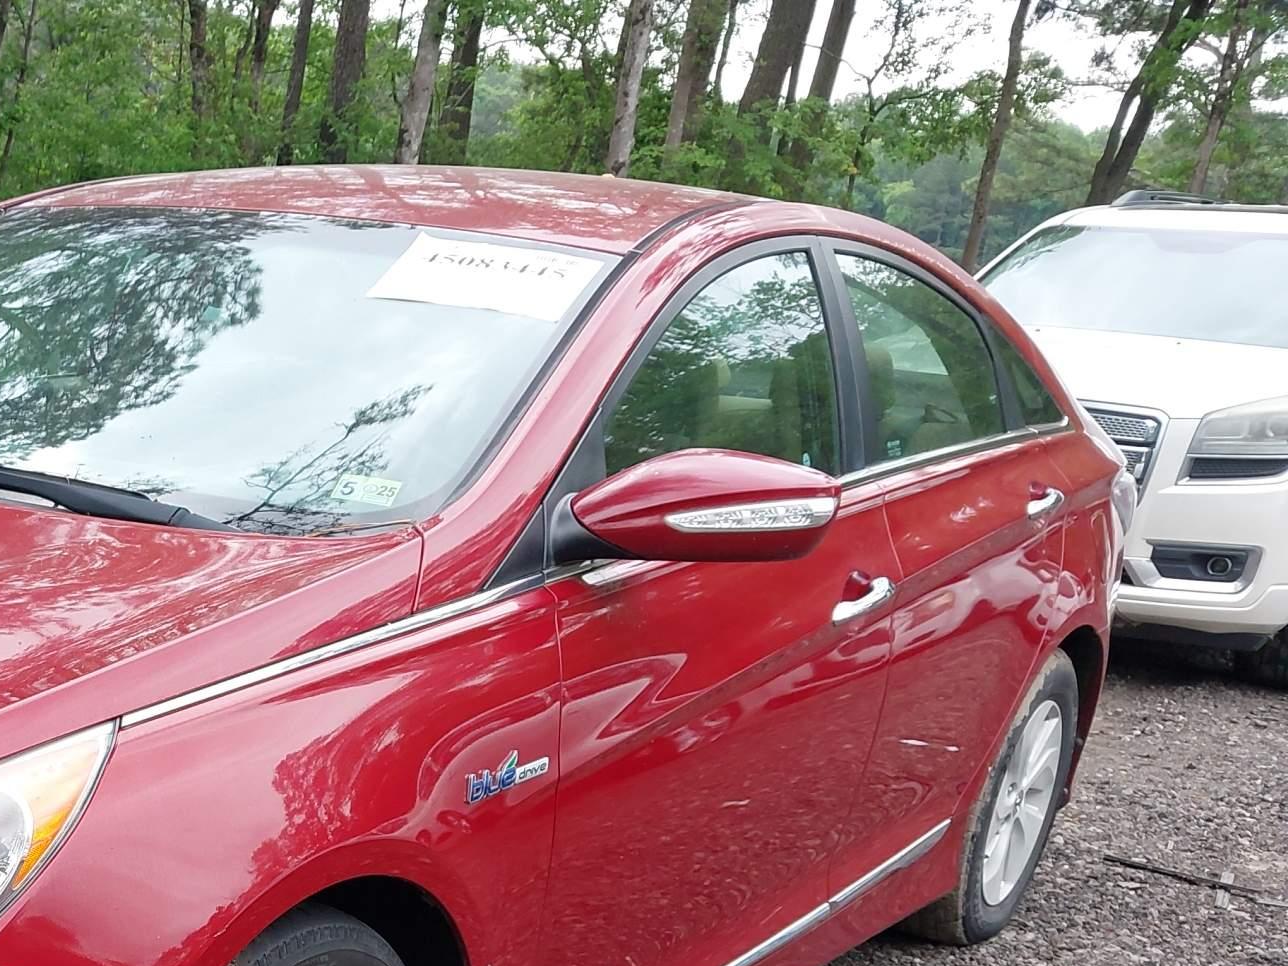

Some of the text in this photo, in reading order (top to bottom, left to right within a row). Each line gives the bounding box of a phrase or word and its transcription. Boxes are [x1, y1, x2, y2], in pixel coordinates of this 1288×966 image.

[340, 481, 358, 496] 5
[376, 485, 398, 498] 25
[465, 756, 548, 804] blue drive
